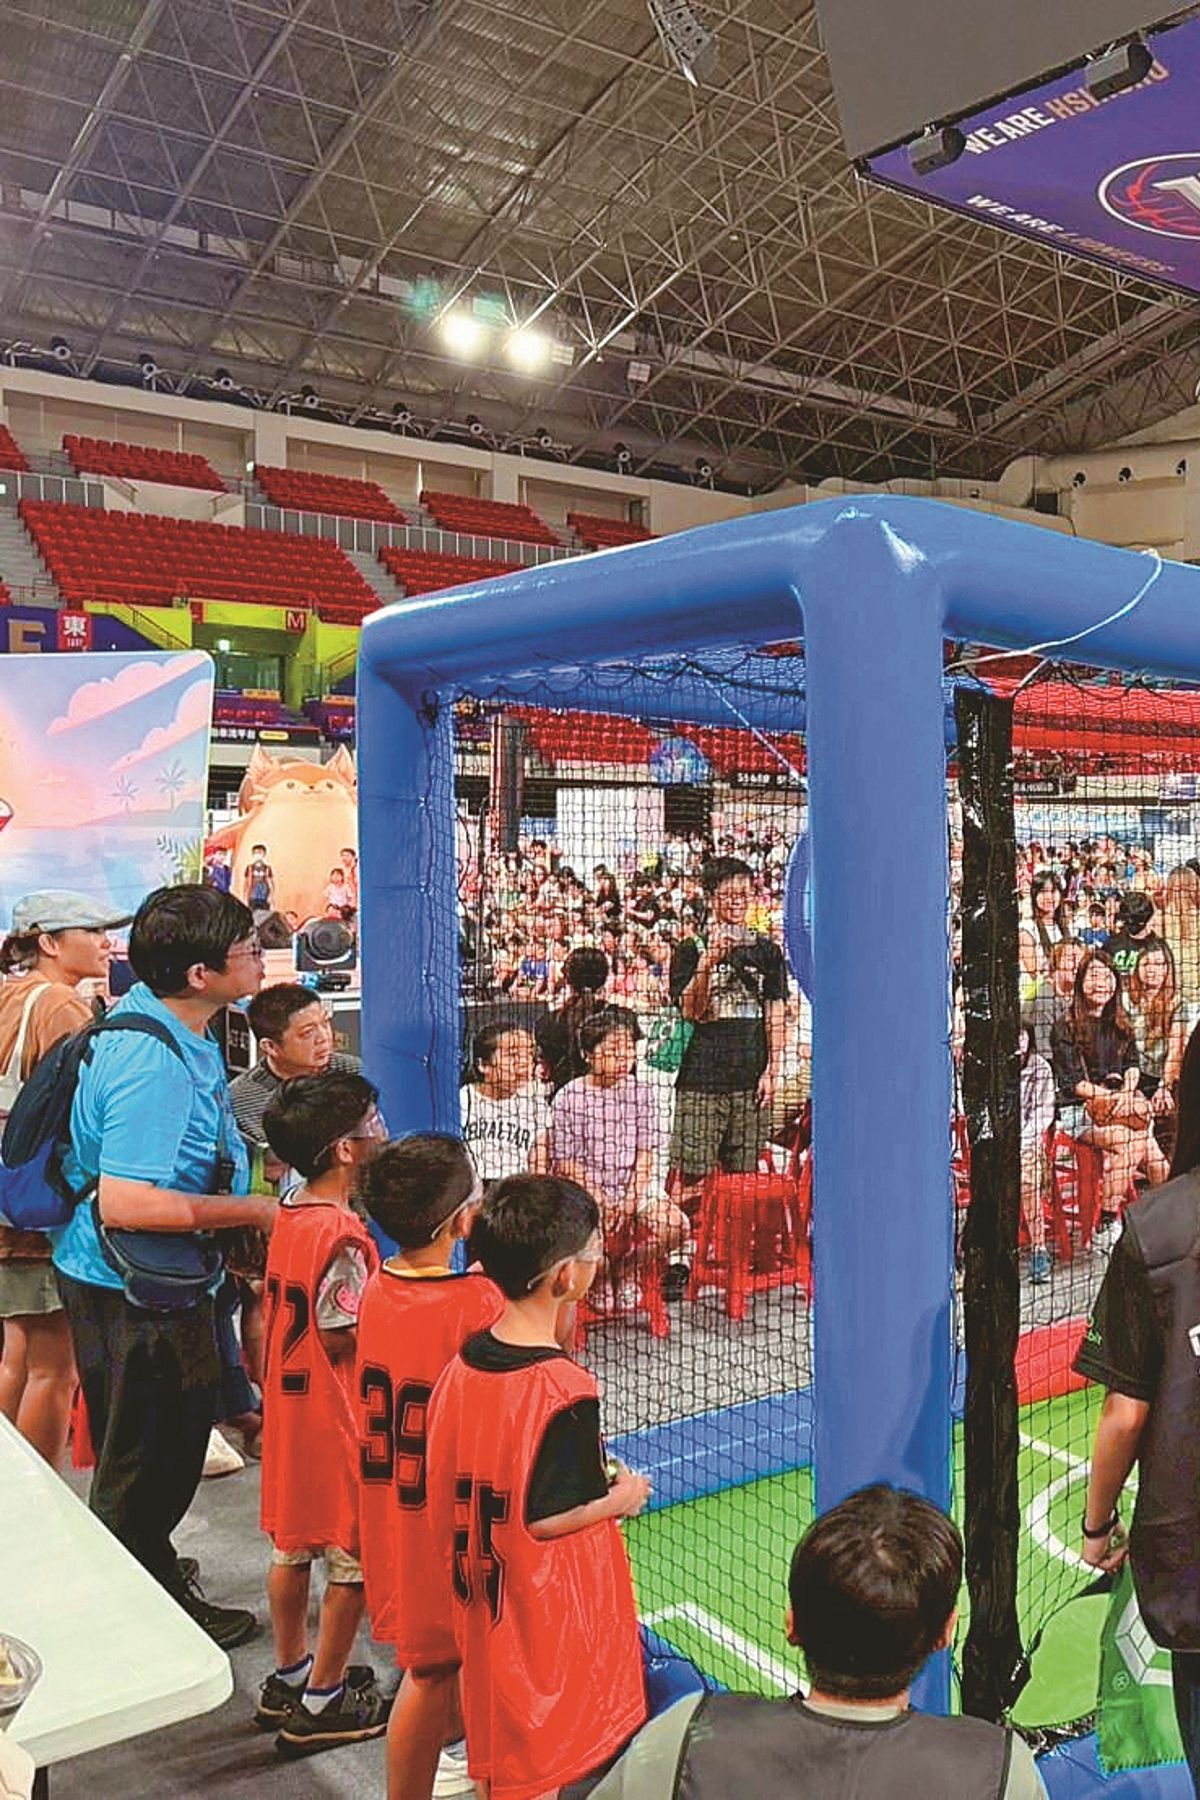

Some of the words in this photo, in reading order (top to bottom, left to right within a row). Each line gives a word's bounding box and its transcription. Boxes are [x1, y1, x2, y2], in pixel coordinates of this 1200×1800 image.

[963, 126, 1009, 155] WE
[999, 107, 1055, 142] ARE
[287, 611, 305, 629] M
